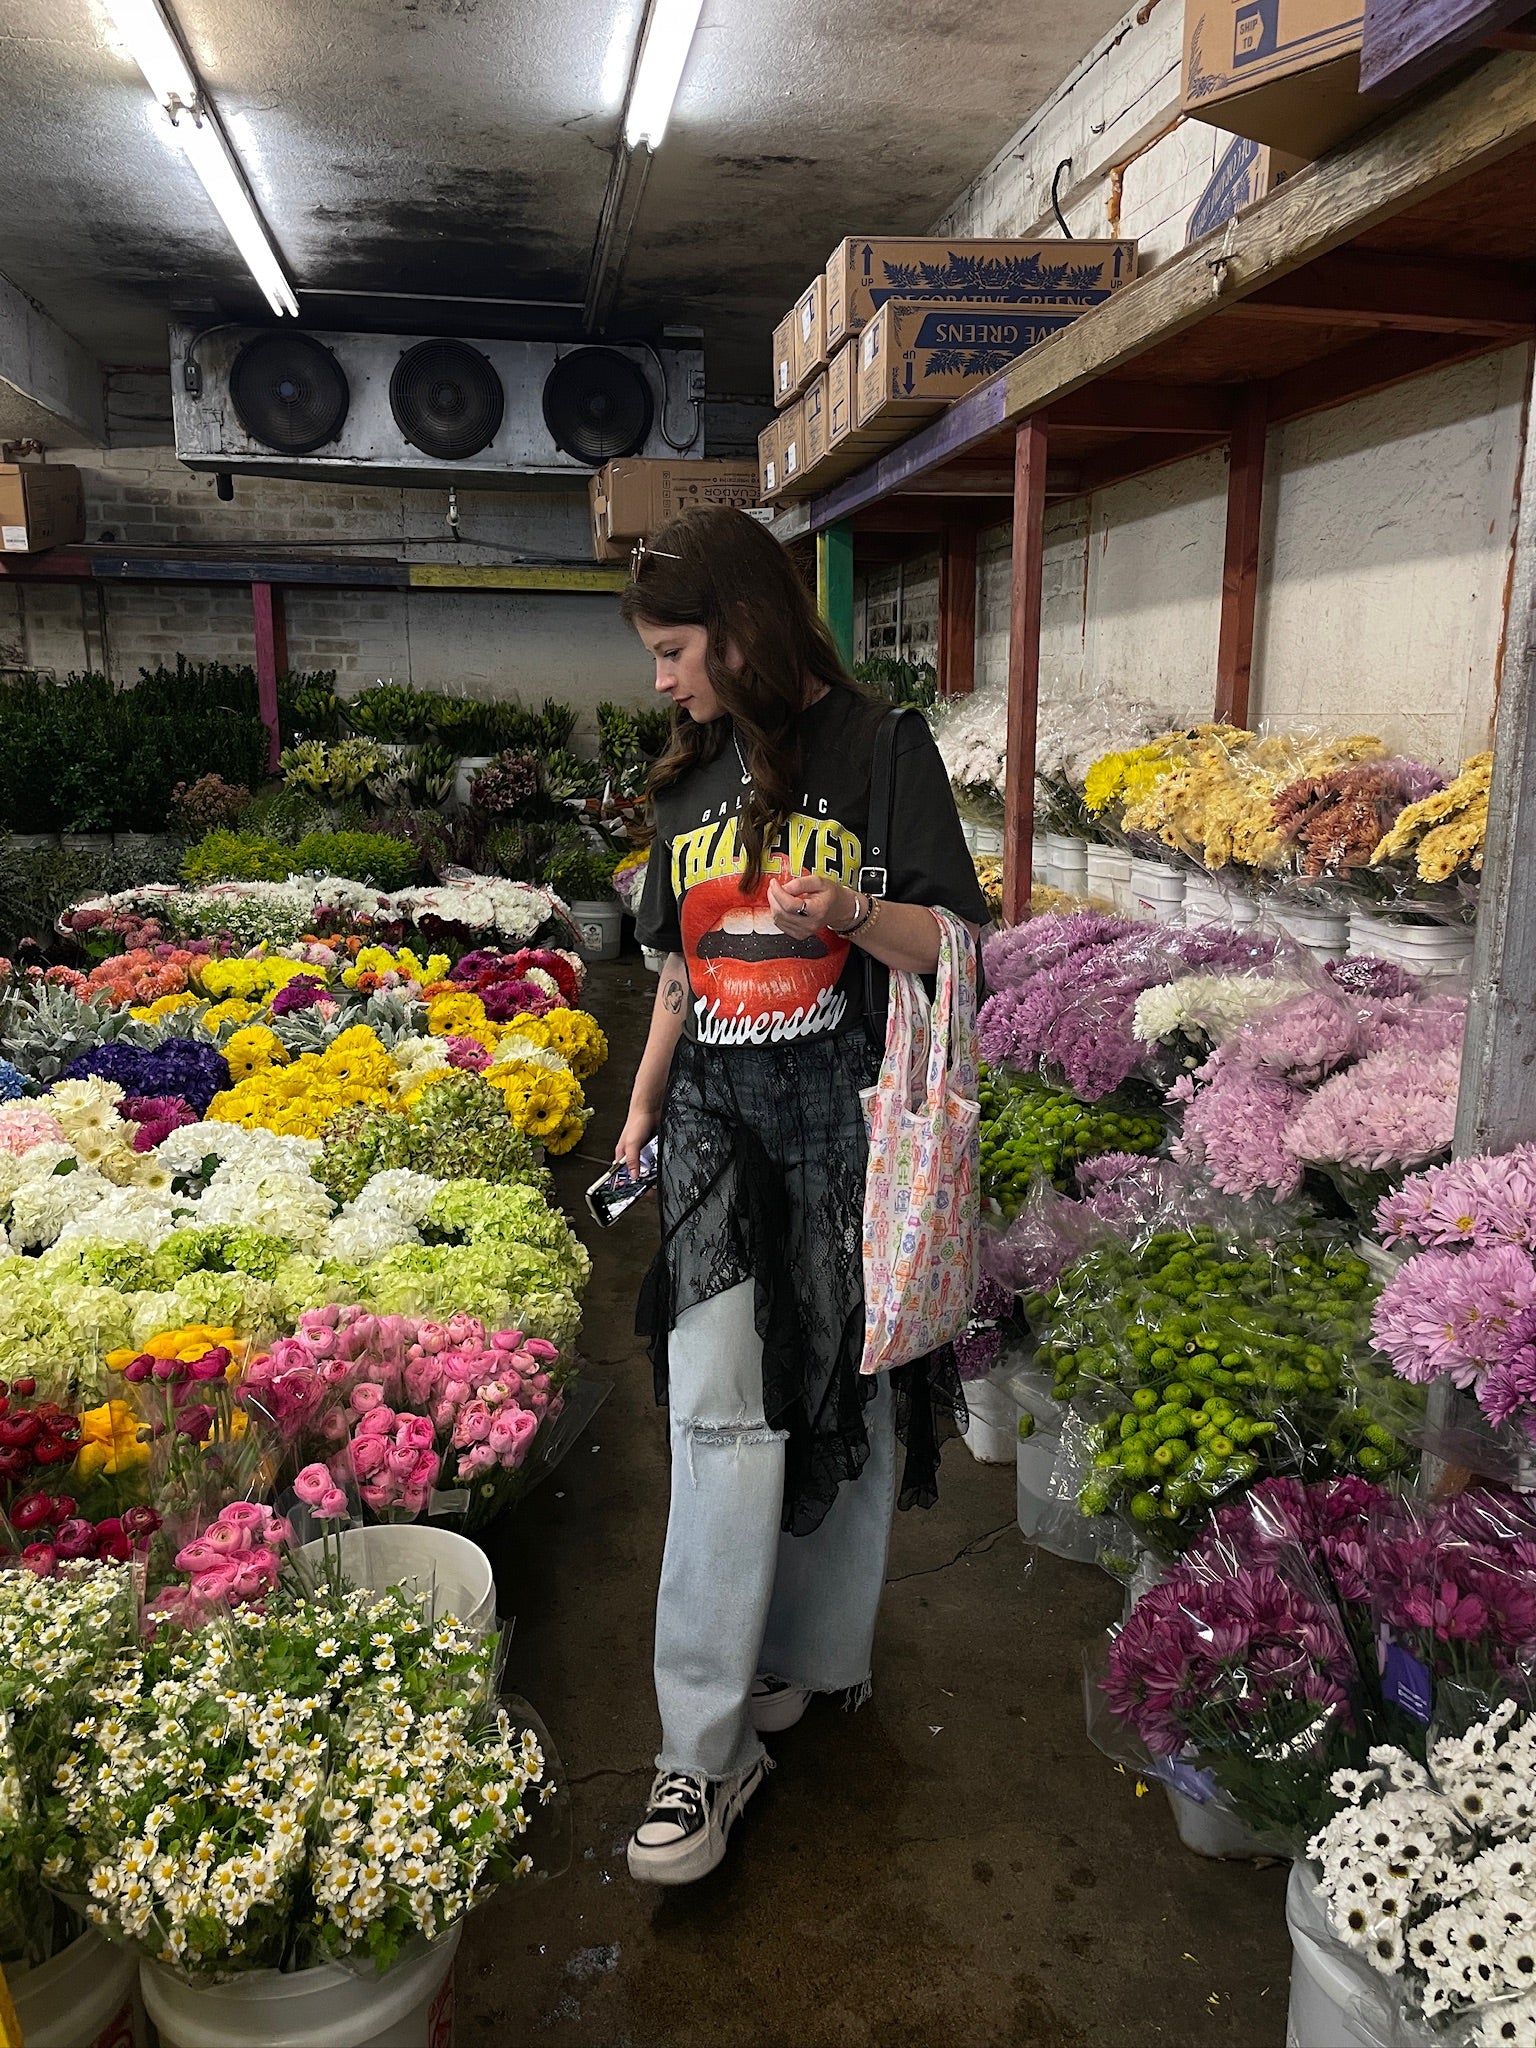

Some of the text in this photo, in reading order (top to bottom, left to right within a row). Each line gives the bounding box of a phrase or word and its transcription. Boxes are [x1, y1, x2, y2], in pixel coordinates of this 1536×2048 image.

[1239, 17, 1259, 36] SHIP
[1243, 36, 1253, 49] TO
[861, 277, 874, 288] UP
[1110, 279, 1123, 290] UP
[936, 323, 1018, 344] GREENS
[902, 350, 916, 360] UP
[693, 984, 848, 1045] University
